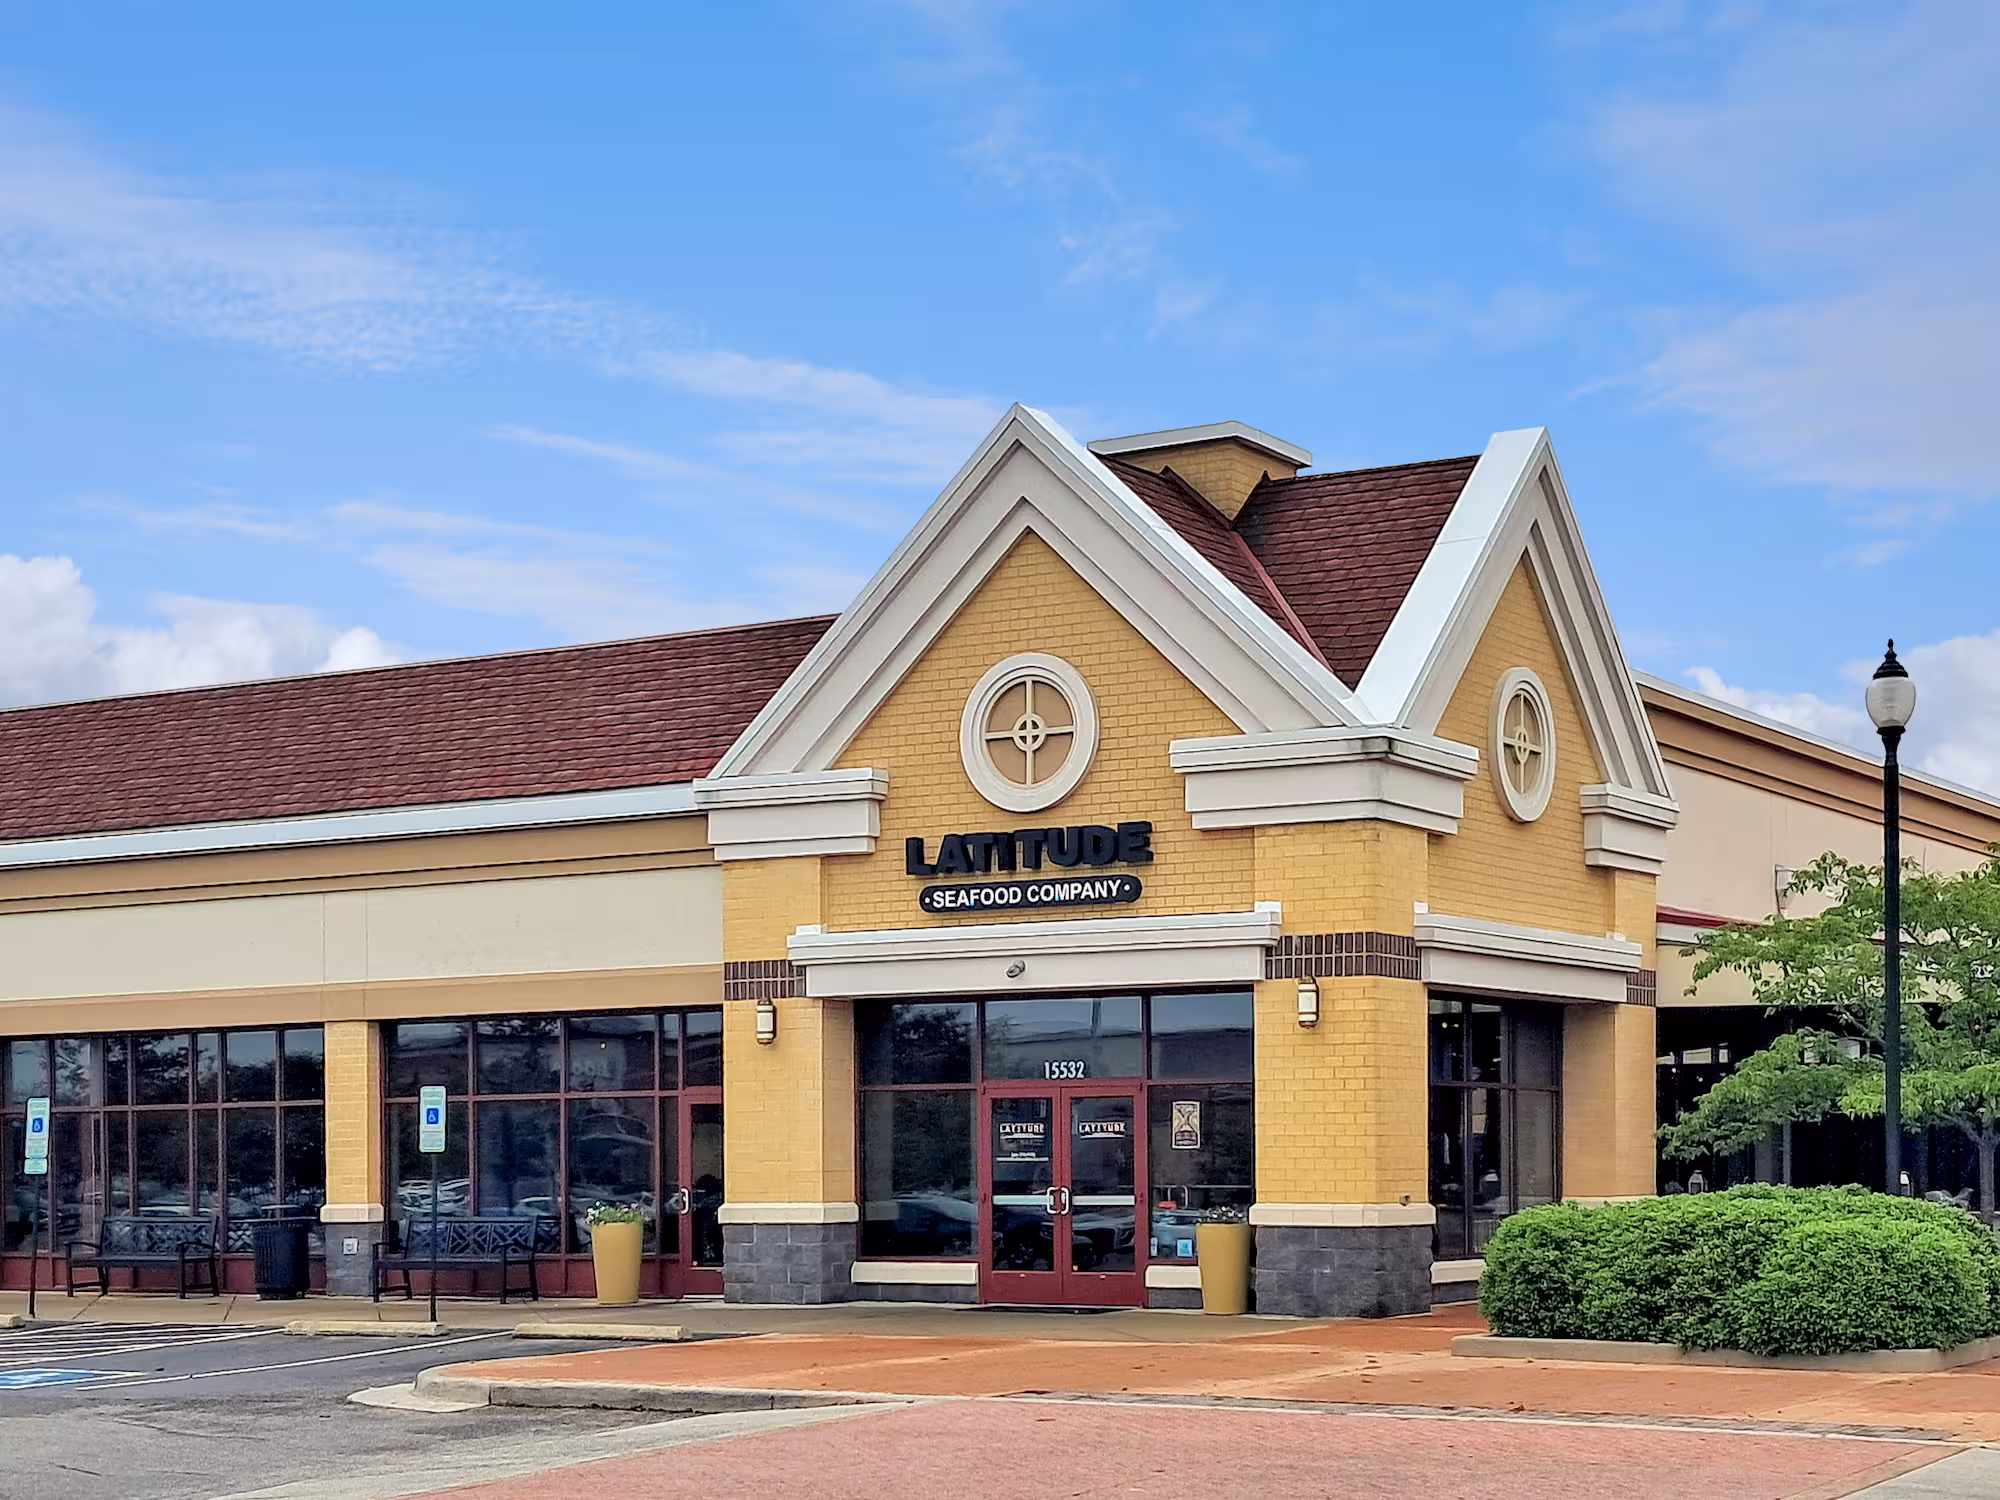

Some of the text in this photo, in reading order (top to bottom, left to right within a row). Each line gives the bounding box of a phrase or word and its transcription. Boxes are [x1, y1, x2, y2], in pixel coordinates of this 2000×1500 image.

[906, 821, 1154, 875] LATITUDE
[932, 879, 1122, 908] SEAFOOD COMPANY
[1044, 1060, 1085, 1079] 15532
